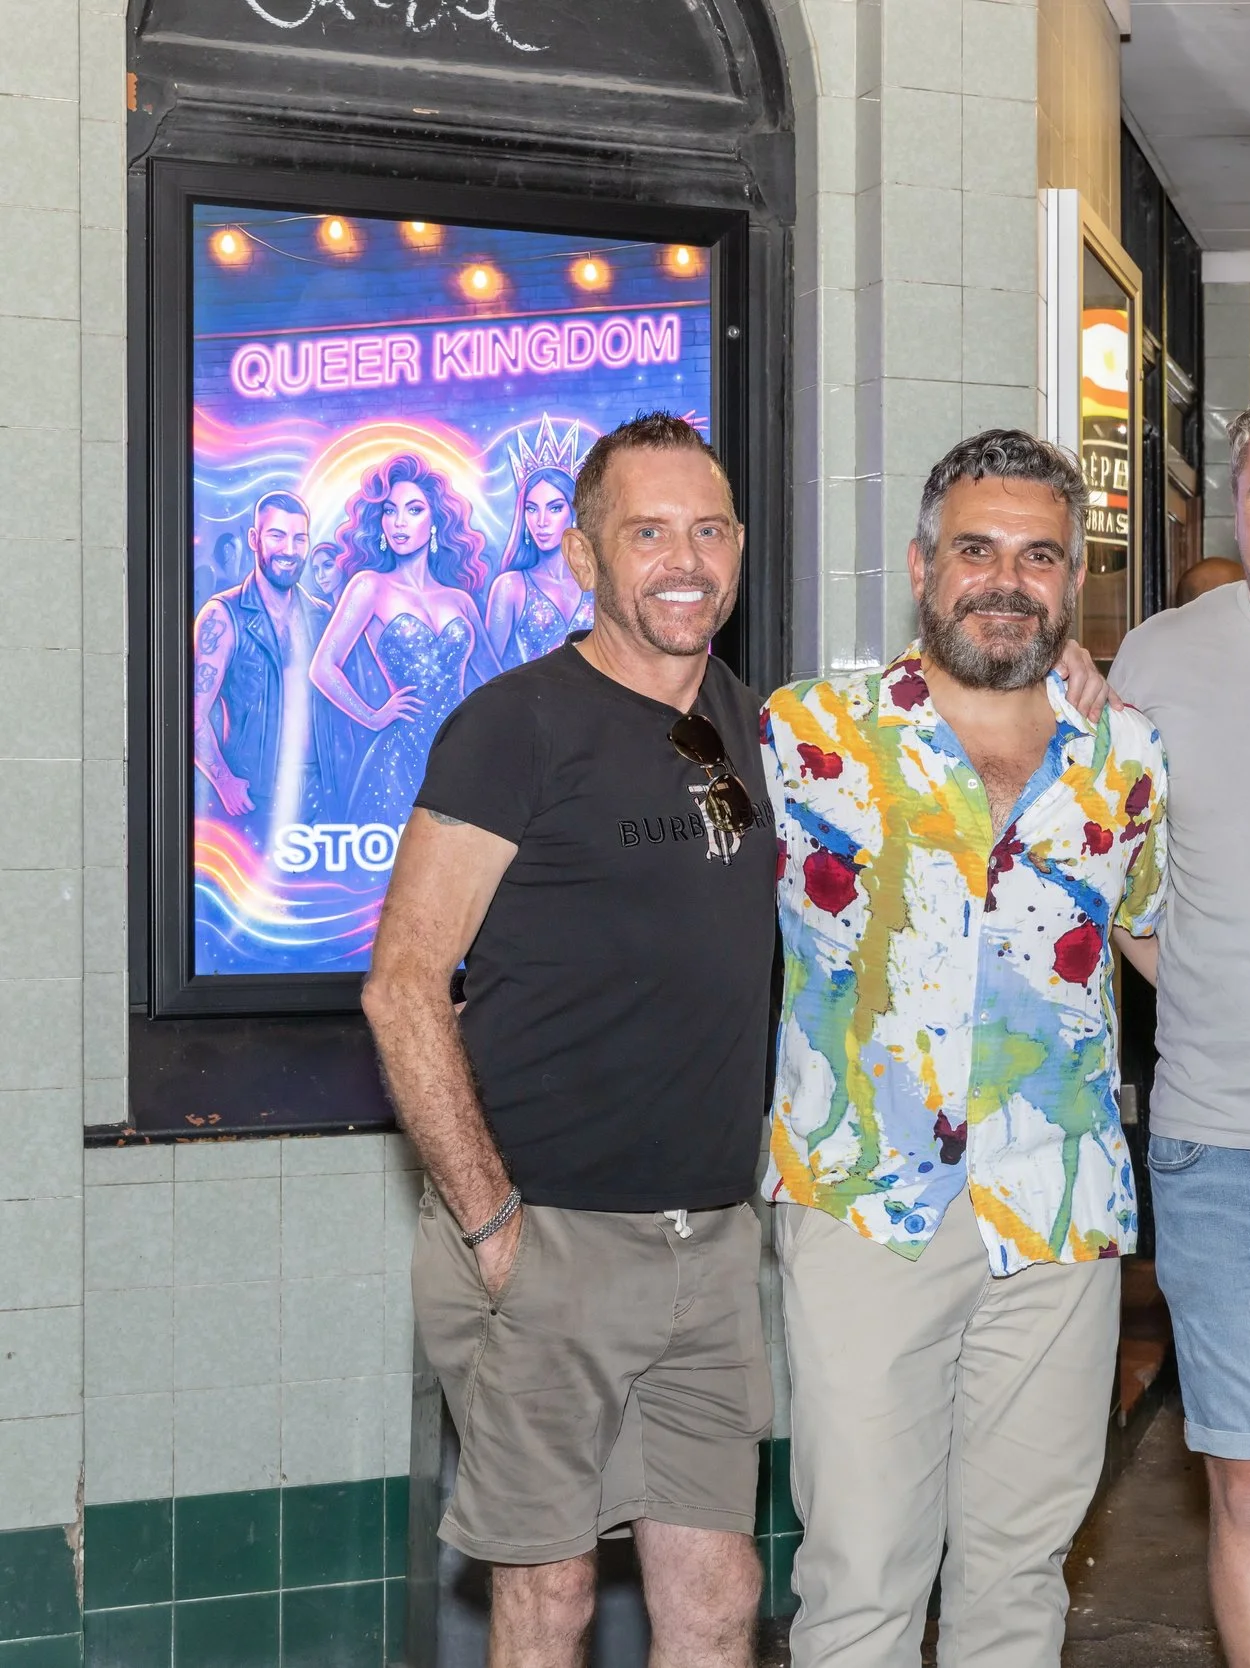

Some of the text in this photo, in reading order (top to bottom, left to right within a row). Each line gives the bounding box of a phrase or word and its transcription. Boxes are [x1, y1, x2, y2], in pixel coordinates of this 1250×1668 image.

[235, 315, 680, 396] QUEER KINGDOM
[273, 823, 407, 873] STO
